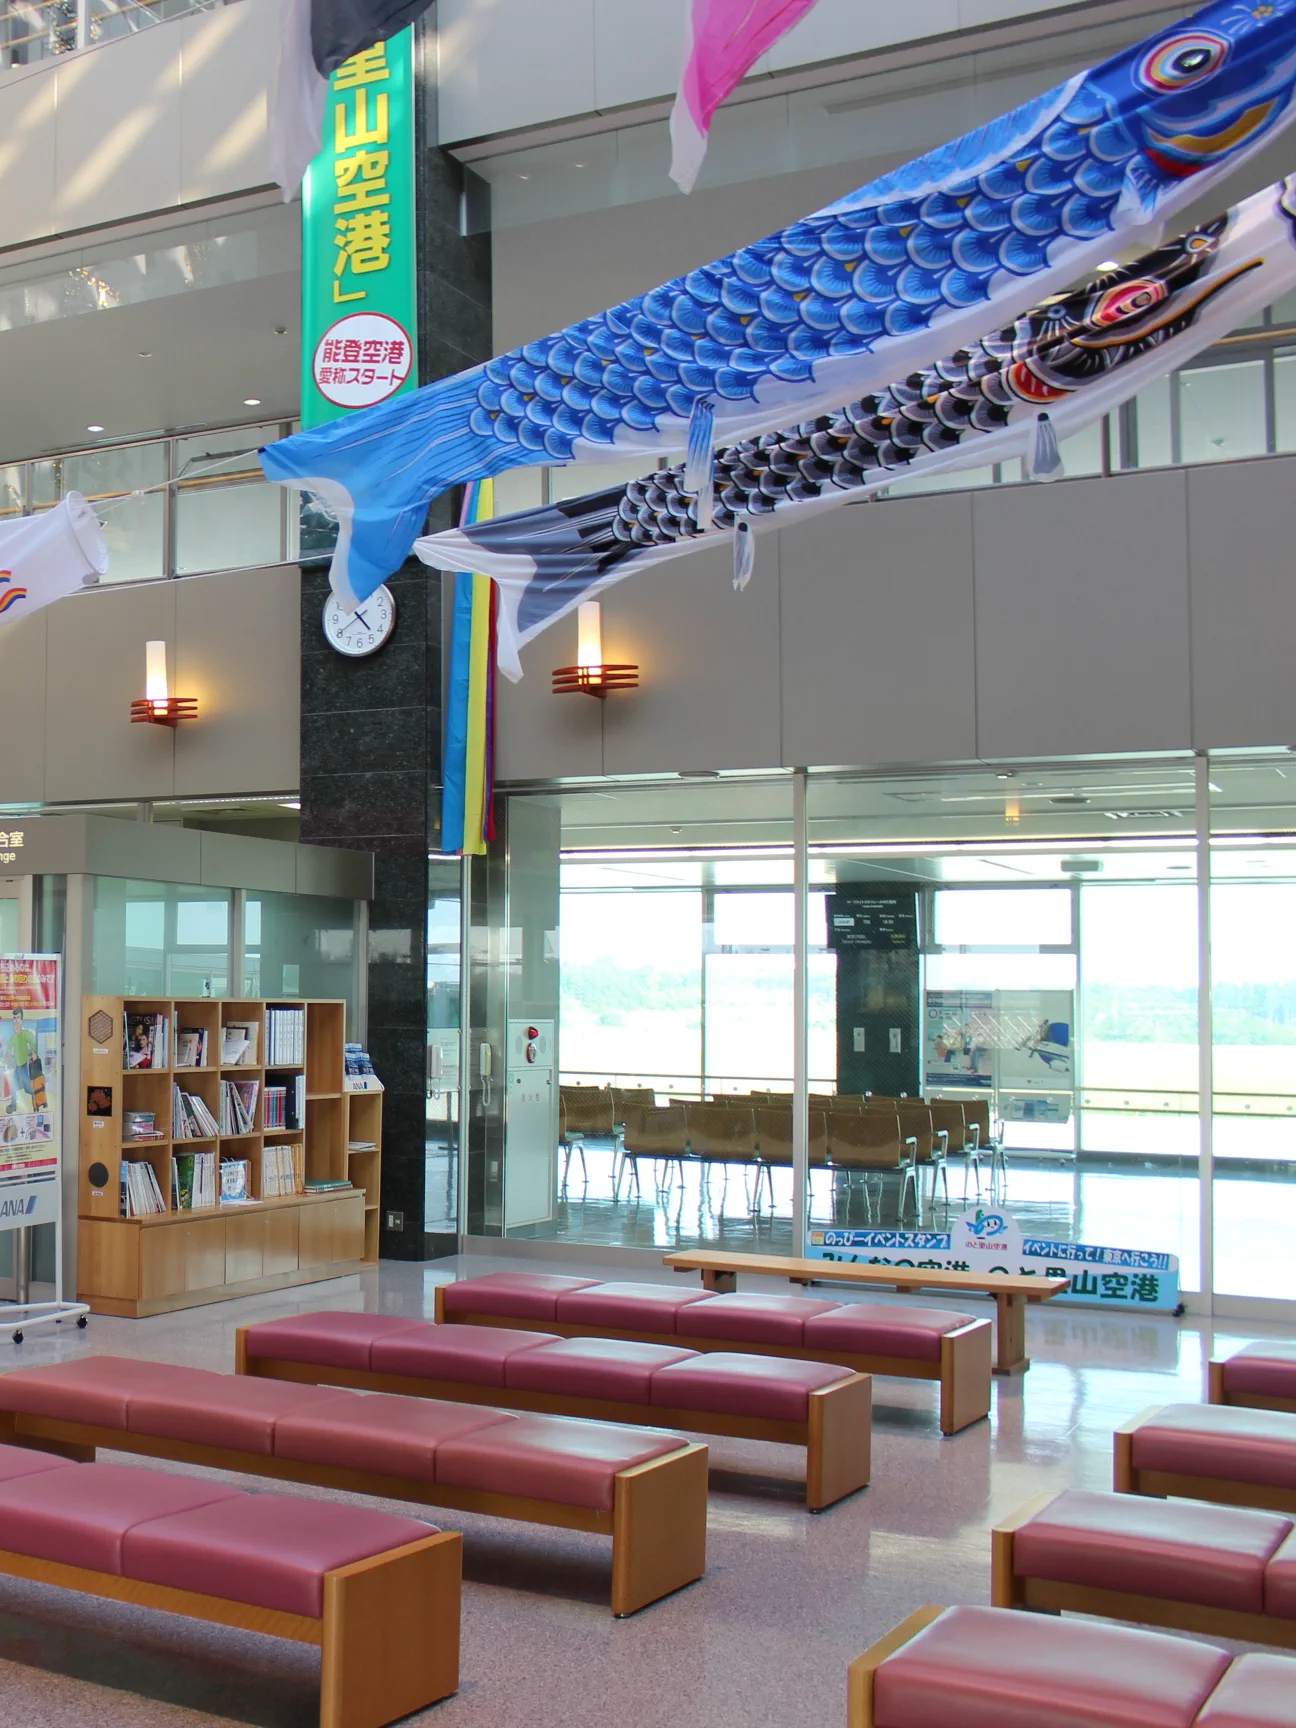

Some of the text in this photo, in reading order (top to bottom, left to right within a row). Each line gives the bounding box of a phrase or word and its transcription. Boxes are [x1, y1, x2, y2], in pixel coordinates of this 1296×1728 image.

[321, 338, 406, 366] 能登空港
[318, 365, 405, 387] 愛称スタート
[377, 596, 384, 607] 2
[332, 614, 339, 625] 9
[380, 609, 387, 620] 3
[336, 628, 343, 639] 8
[376, 624, 384, 633] 4
[346, 636, 352, 646] 7
[356, 638, 363, 648] 6
[368, 634, 375, 645] 5
[0, 1198, 26, 1218] ANA
[824, 1230, 948, 1249] のっぴーイベントスタンプ
[965, 1241, 1008, 1251] のと里山空港
